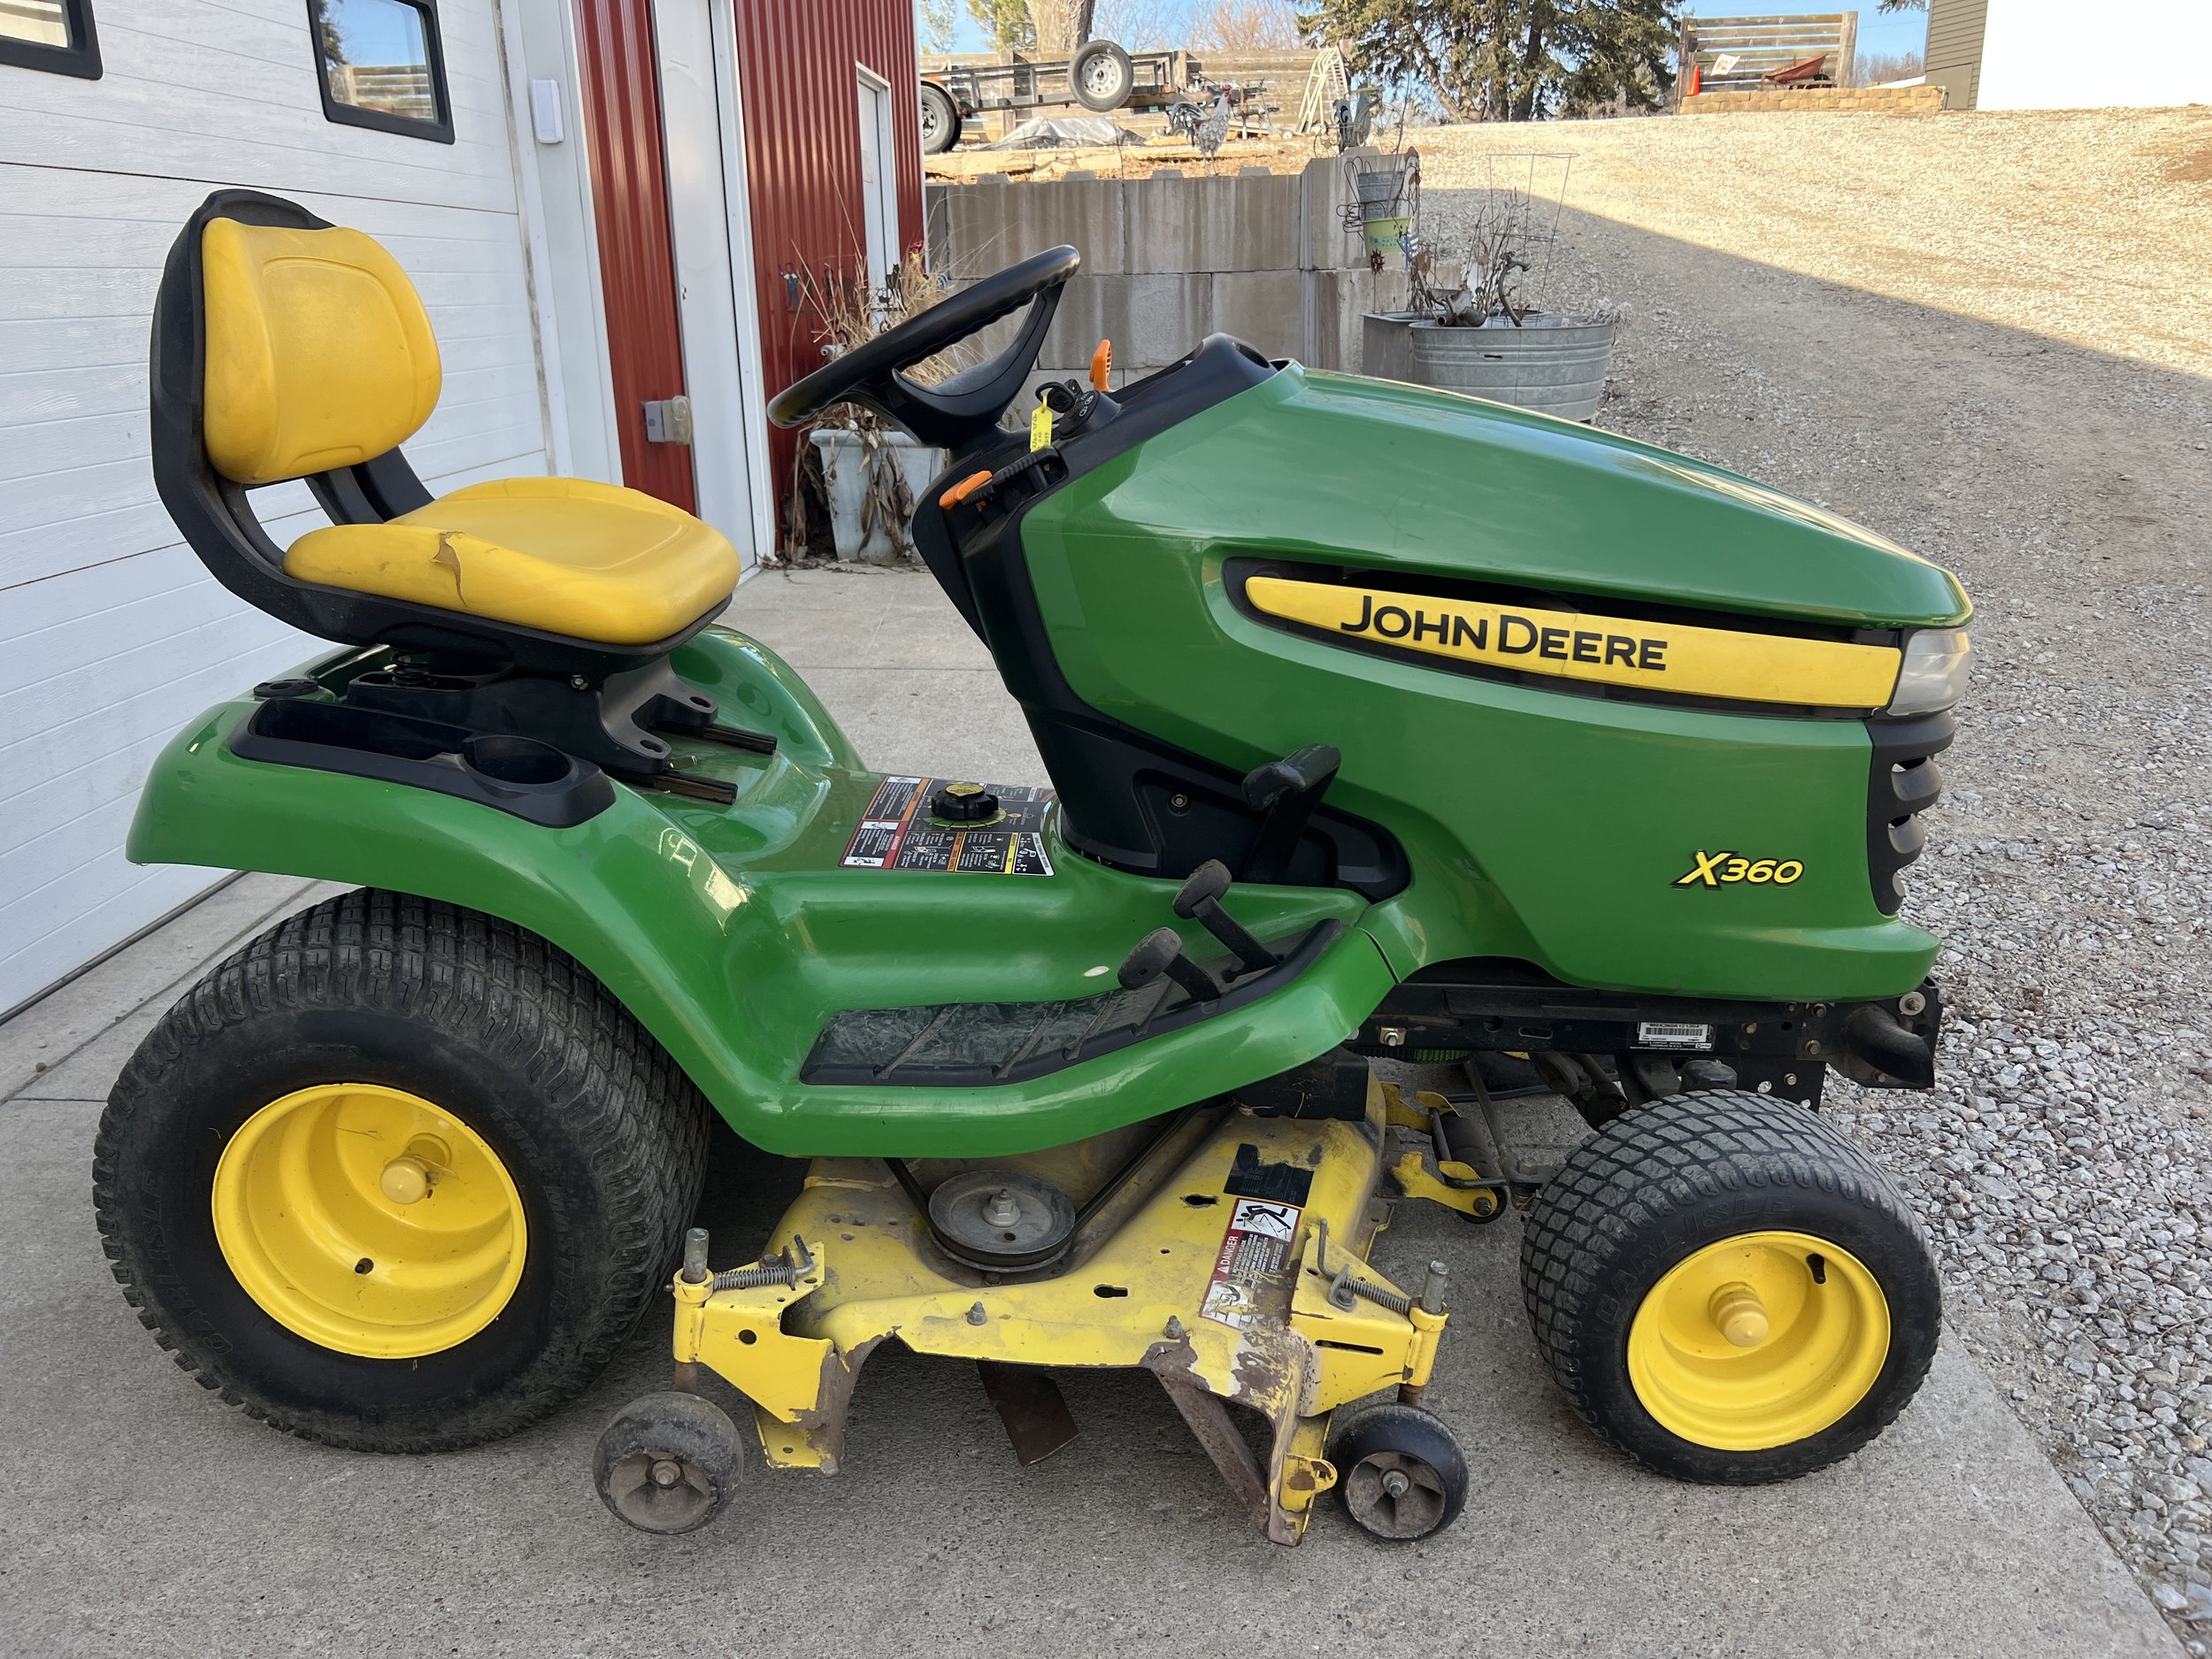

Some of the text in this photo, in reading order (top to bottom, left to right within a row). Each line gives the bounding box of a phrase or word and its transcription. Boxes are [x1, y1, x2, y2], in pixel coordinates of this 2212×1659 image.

[1340, 595, 1668, 672] JOHN DEERE
[1671, 849, 1805, 888] X360
[1220, 1235, 1239, 1265] DANGER
[1594, 1194, 1793, 1325] CARLISLE
